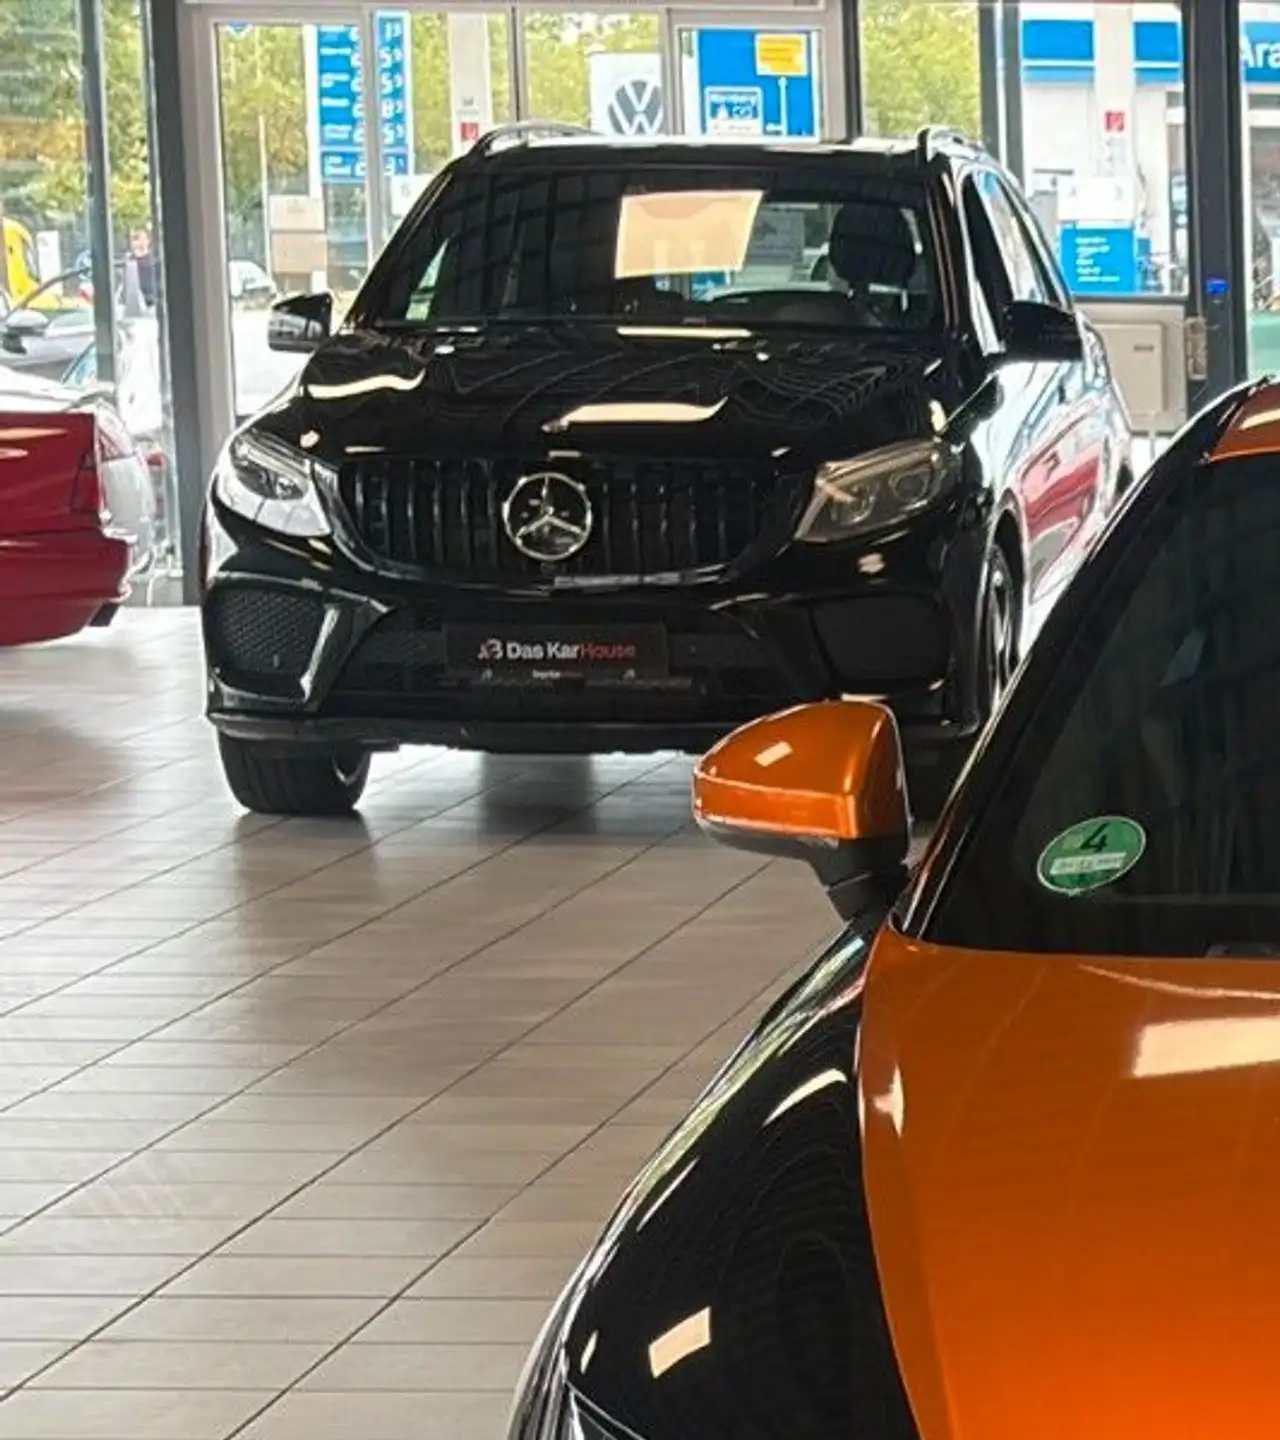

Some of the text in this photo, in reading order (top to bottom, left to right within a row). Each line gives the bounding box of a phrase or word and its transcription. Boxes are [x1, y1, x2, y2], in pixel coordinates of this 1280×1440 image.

[506, 642, 544, 660] Das
[546, 641, 636, 660] KarHouse
[1079, 822, 1109, 853] 4
